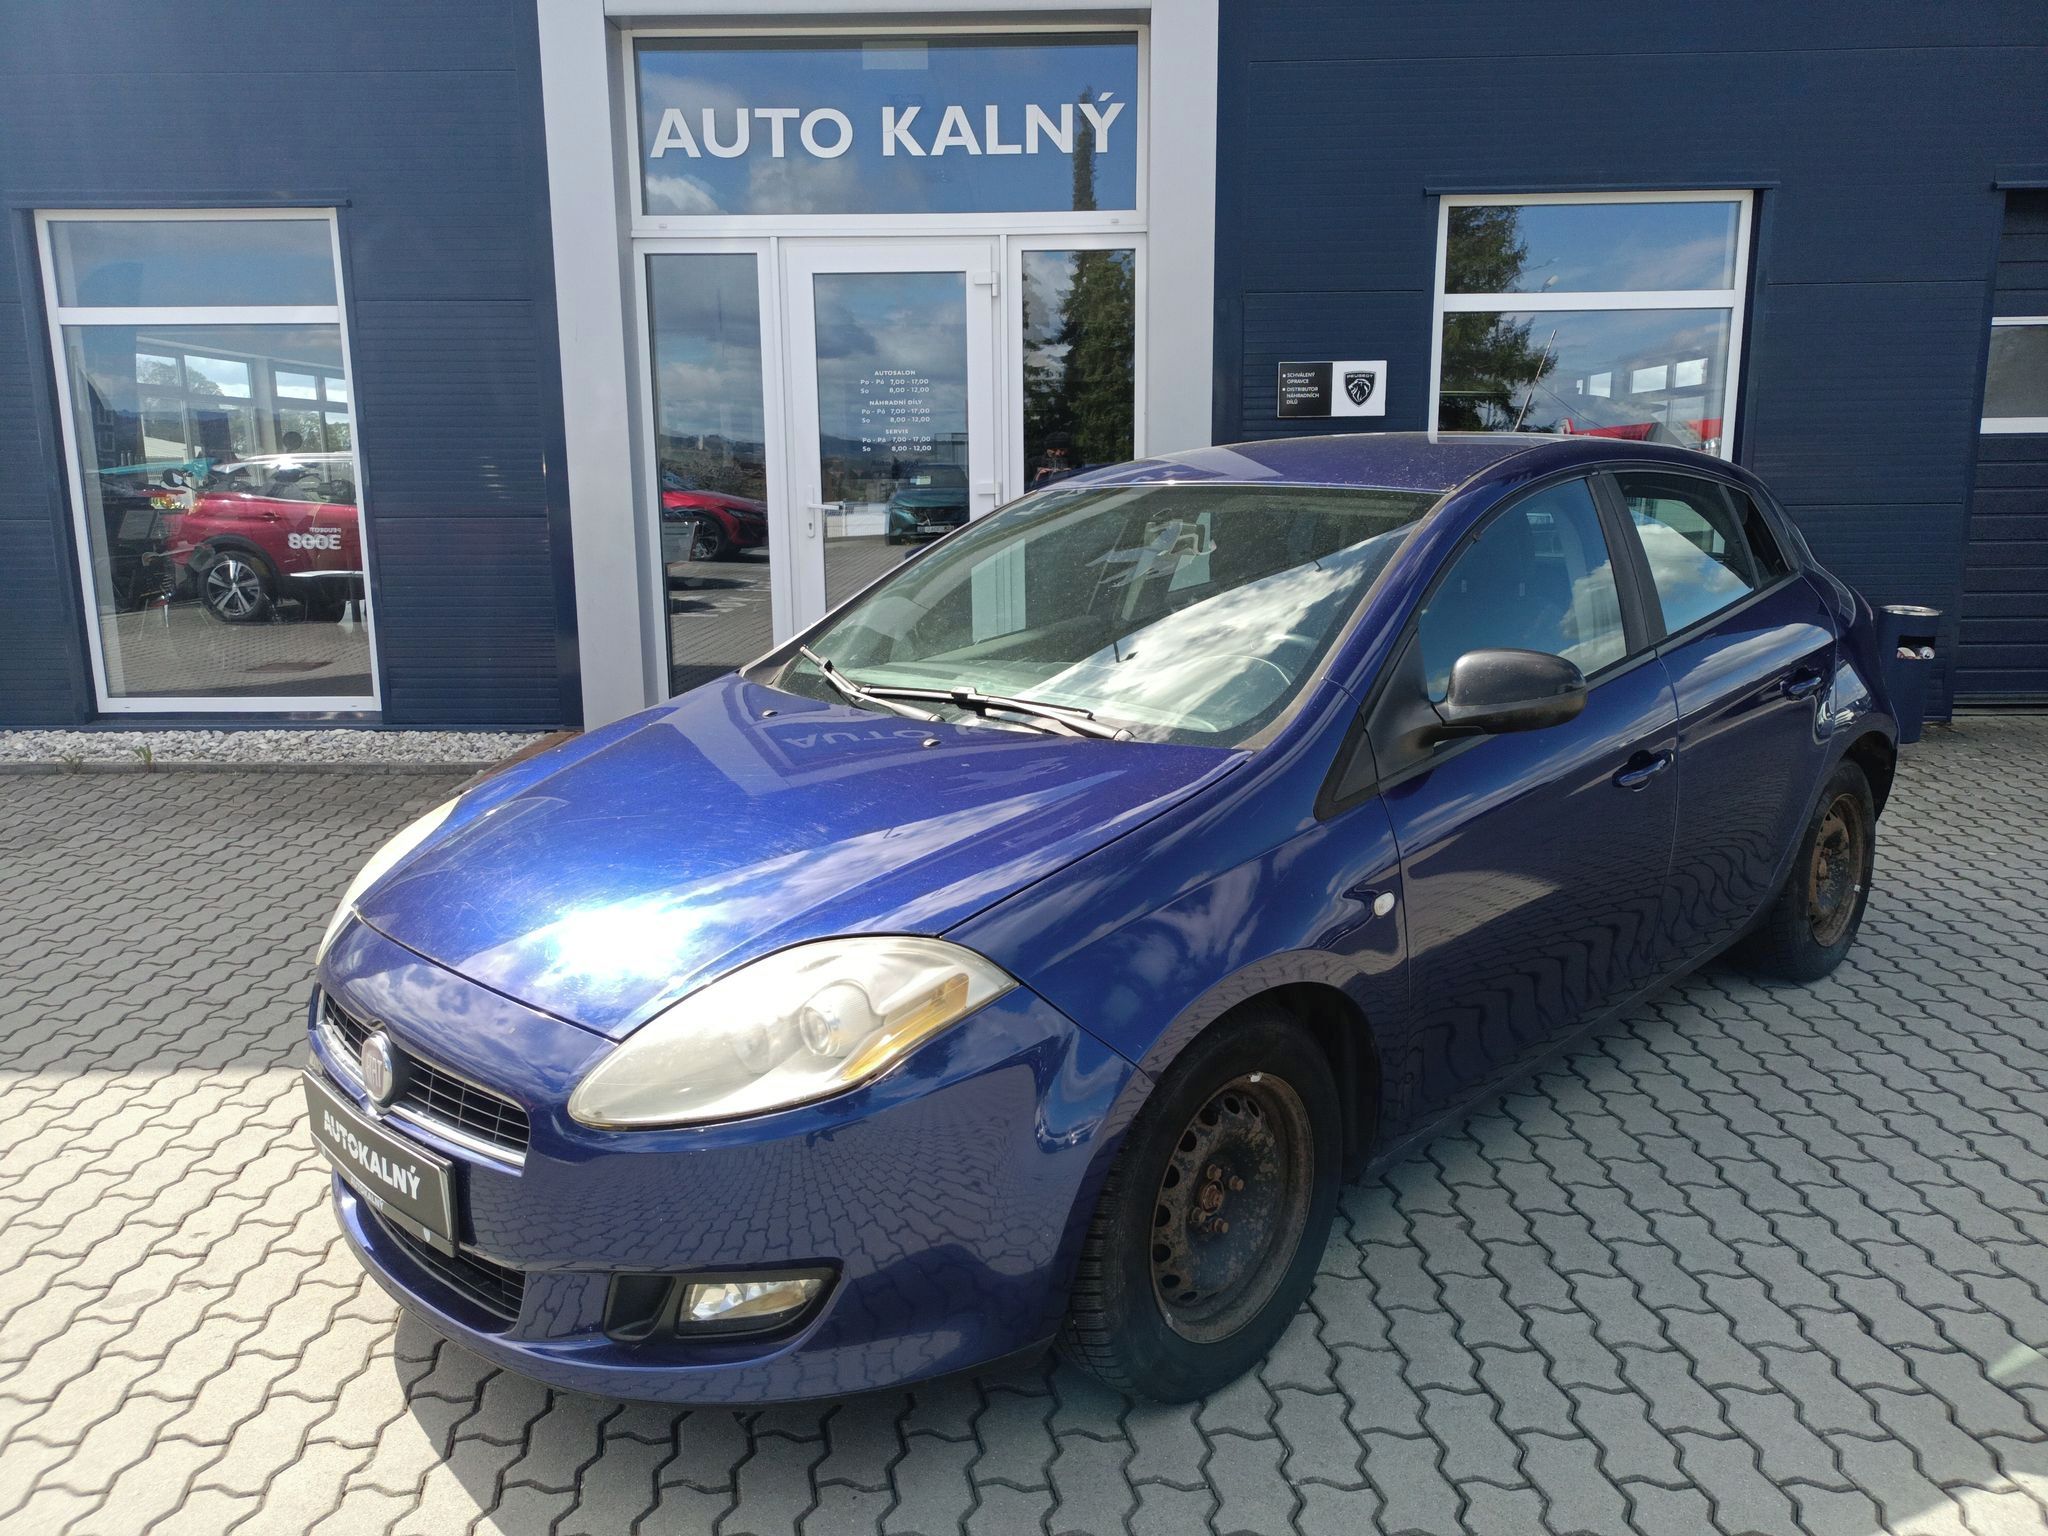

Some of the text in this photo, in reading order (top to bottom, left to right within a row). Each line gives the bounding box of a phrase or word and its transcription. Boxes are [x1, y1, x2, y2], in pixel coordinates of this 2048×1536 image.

[650, 92, 1125, 159] AUTO KALNÝ
[323, 1109, 422, 1200] AUTOKALNÝ
